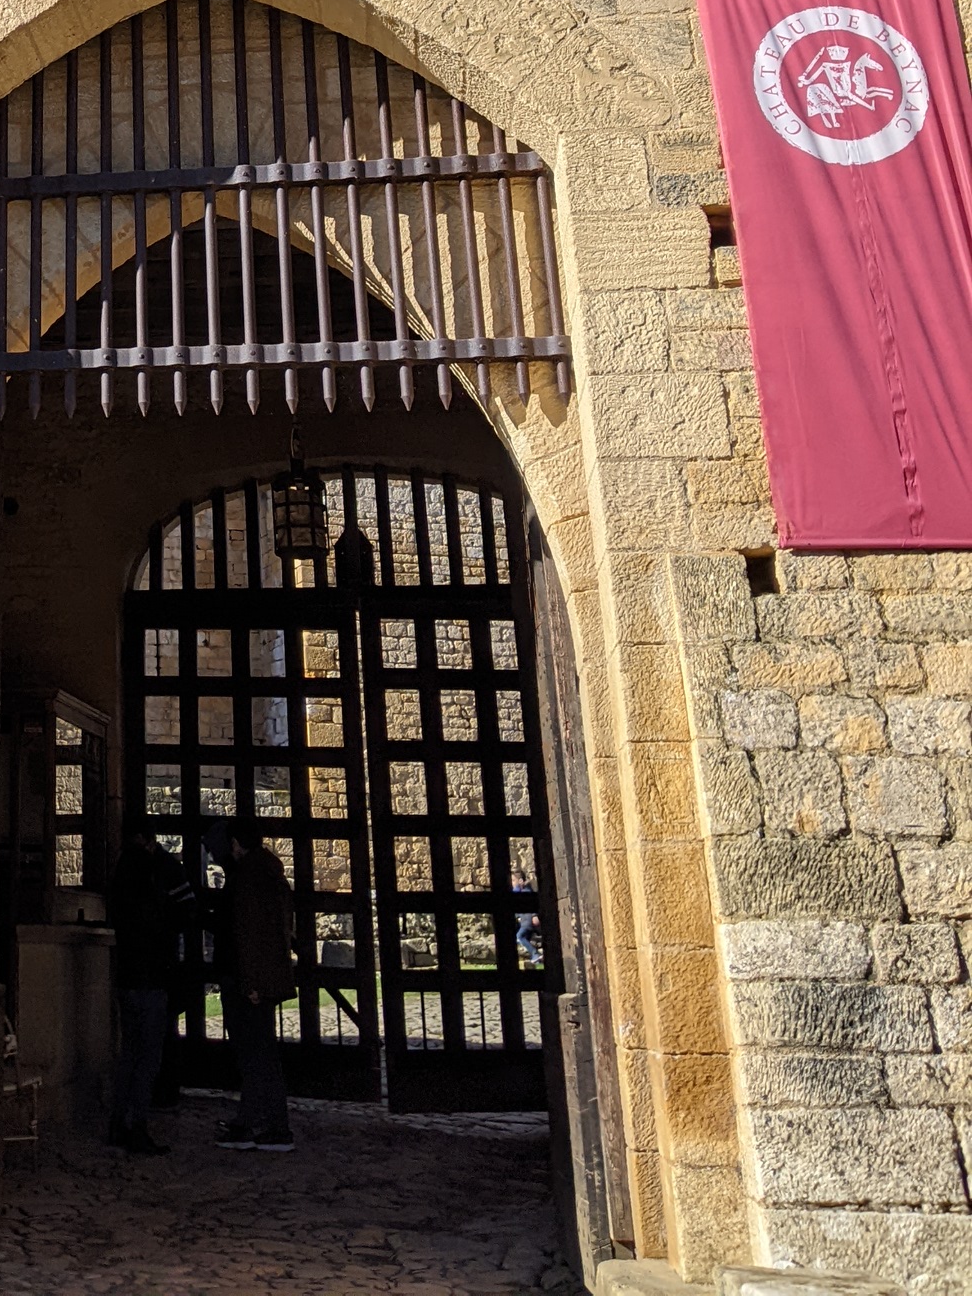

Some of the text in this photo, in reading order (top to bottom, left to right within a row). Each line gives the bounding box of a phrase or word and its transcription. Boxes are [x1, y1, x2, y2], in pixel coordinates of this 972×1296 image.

[760, 12, 924, 136] CHATEAU DE BEYNAC
